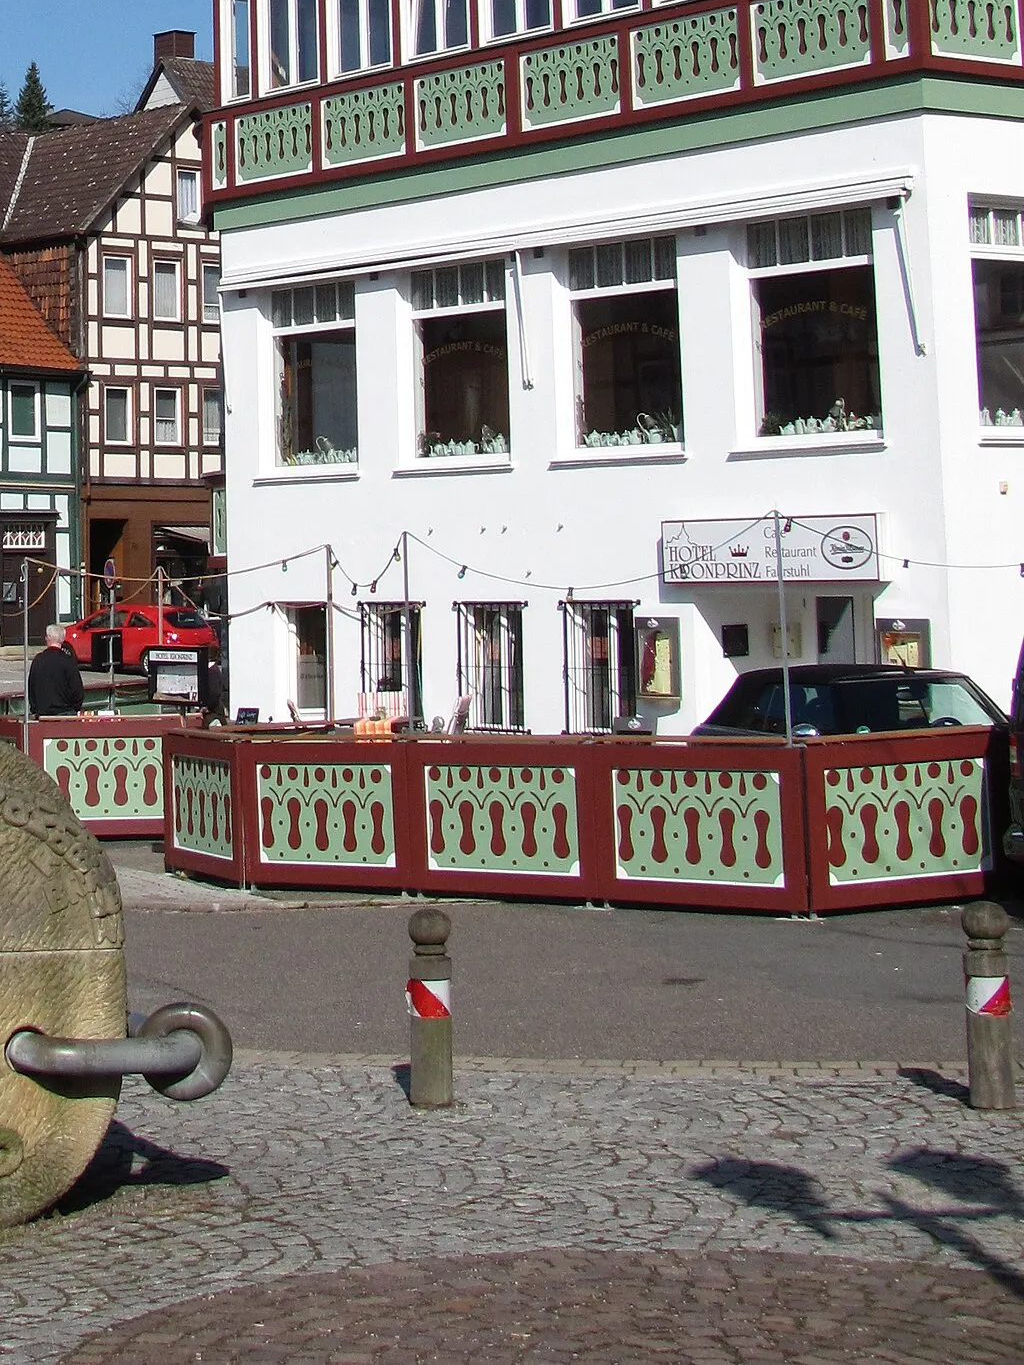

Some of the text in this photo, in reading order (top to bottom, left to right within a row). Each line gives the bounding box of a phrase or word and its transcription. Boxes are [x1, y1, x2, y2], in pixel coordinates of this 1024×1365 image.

[669, 545, 716, 562] HOTEL
[764, 546, 817, 558] Retaurant
[669, 562, 761, 579] KRONPRINZ
[765, 564, 811, 578] Farstuhl
